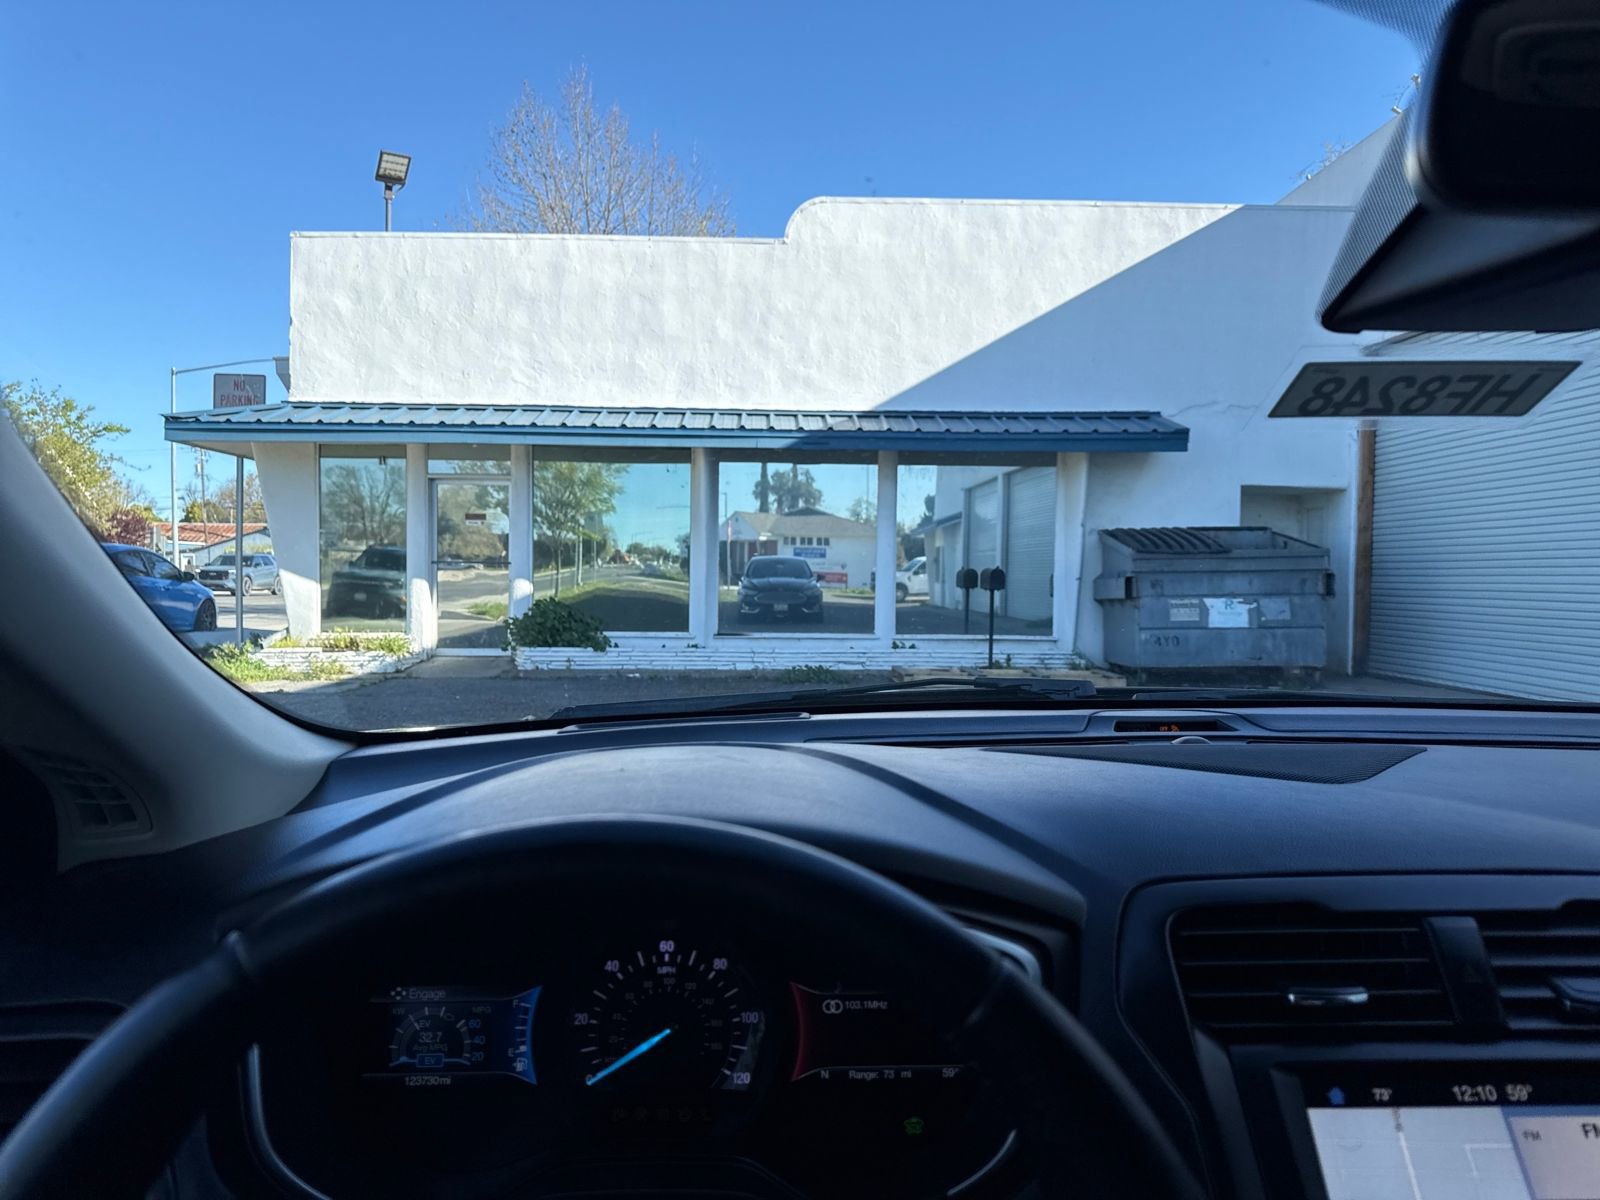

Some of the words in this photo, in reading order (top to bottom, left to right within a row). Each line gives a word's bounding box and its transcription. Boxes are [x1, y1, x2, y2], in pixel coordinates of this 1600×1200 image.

[233, 379, 246, 392] NO
[658, 940, 675, 952] 60
[604, 960, 620, 972] 40
[712, 957, 728, 970] 80
[656, 966, 677, 975] MPH
[408, 989, 447, 1001] Engage
[845, 1000, 889, 1010] 103.1MHz
[573, 1012, 589, 1025] 20
[740, 1011, 759, 1024] 100
[418, 1020, 431, 1028] EV
[468, 1019, 482, 1029] 60
[418, 1031, 443, 1044] 32.7
[473, 1036, 487, 1045] 40
[424, 1056, 437, 1066] EV
[471, 1052, 485, 1062] 20
[732, 1072, 751, 1084] 120
[820, 1070, 830, 1079] N
[849, 1070, 879, 1081] Range:
[883, 1070, 895, 1079] 73
[901, 1070, 912, 1079] mi
[1451, 1084, 1498, 1102] 12:10
